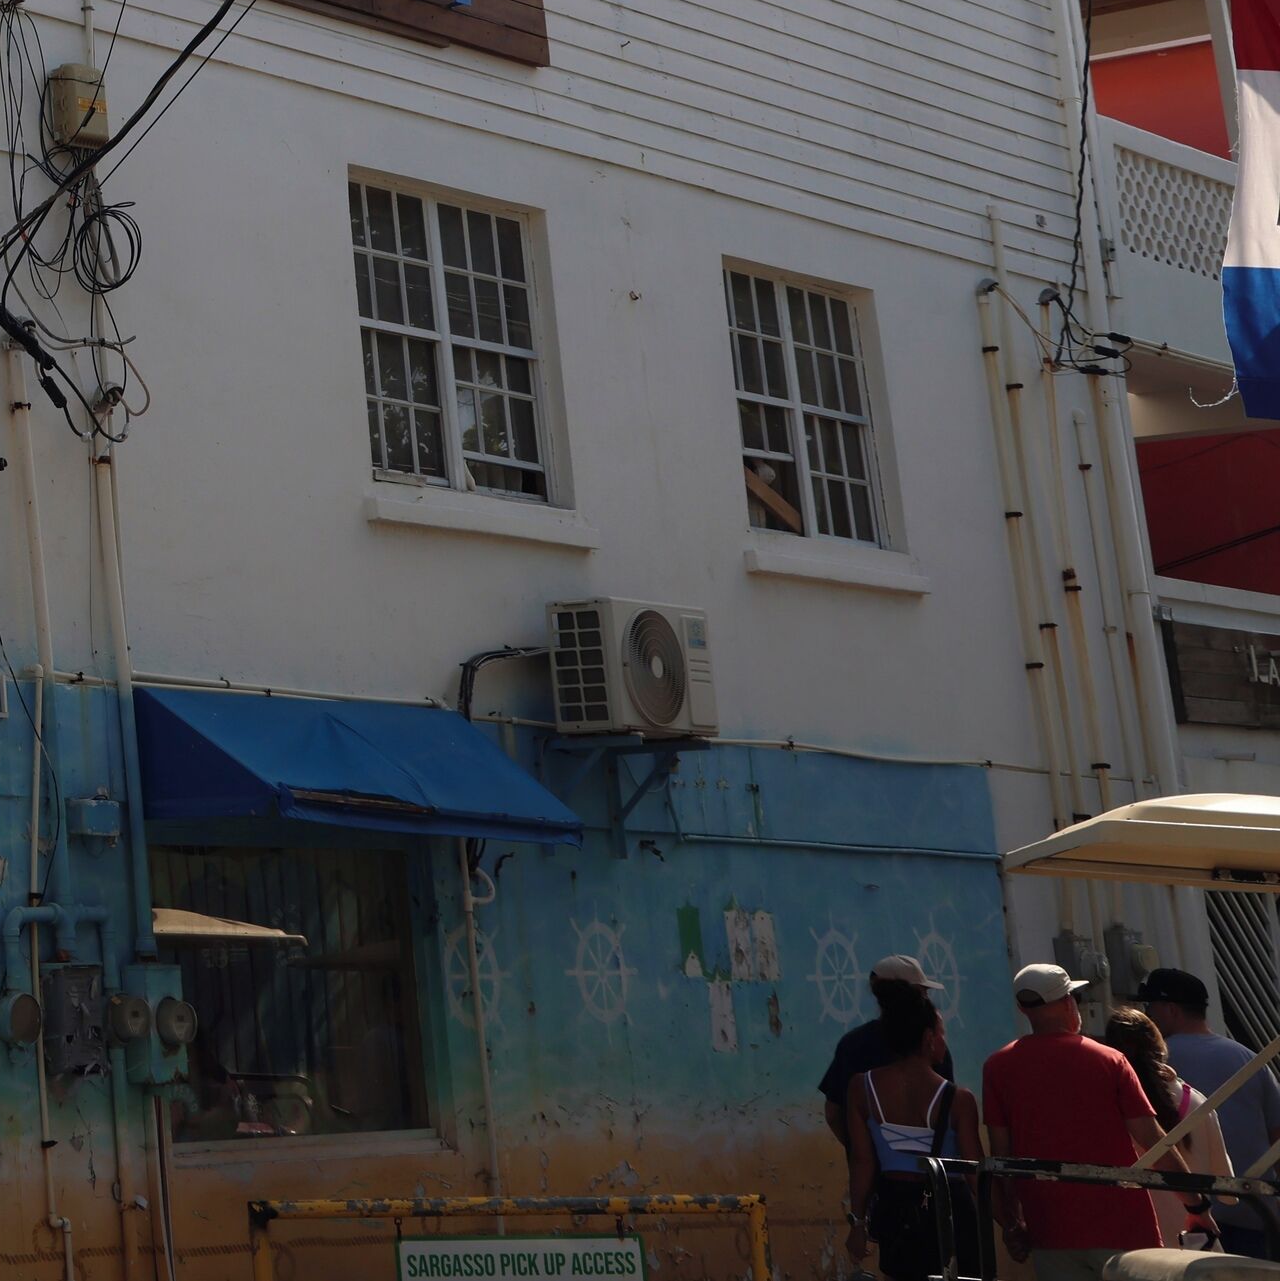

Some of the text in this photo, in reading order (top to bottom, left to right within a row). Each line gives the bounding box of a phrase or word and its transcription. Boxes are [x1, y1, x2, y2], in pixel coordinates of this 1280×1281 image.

[406, 1251, 637, 1277] SARGASSO PICK UP ACCESS
